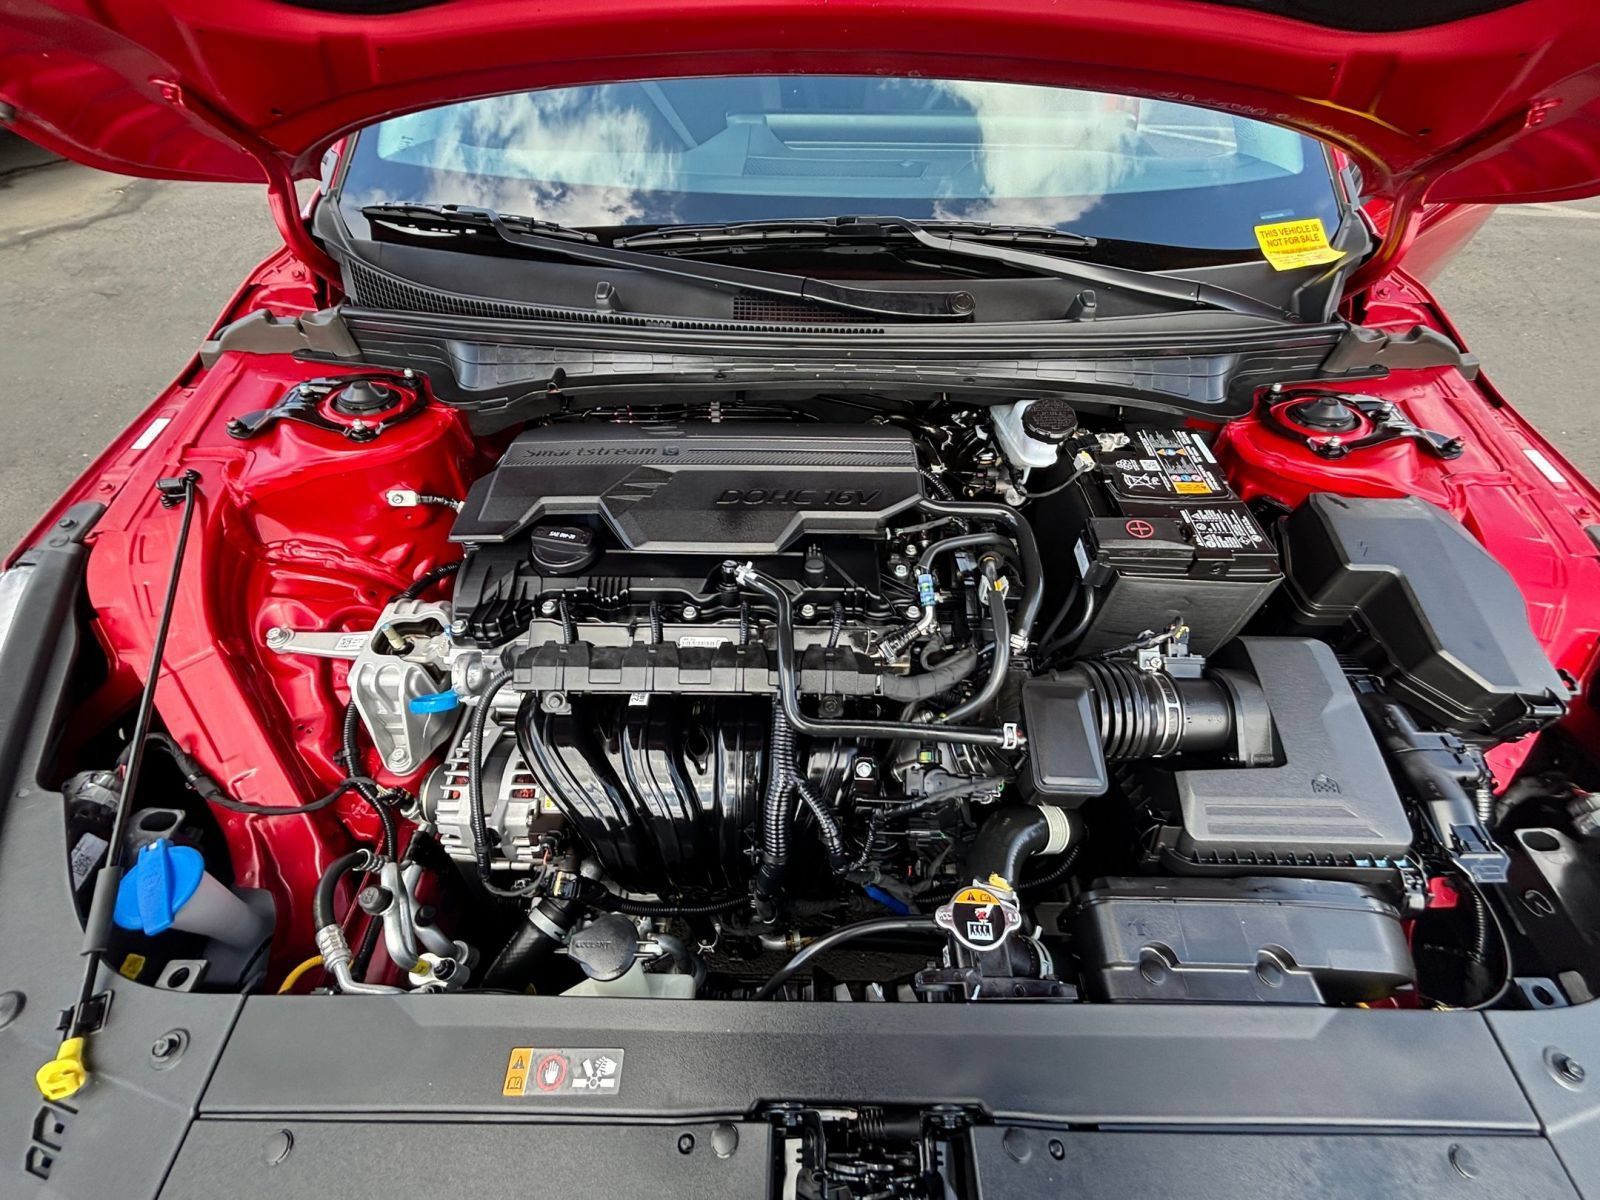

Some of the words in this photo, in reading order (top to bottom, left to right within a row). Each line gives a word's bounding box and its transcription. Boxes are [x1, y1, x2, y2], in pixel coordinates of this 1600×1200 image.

[1260, 229, 1278, 239] THIS
[1279, 225, 1311, 236] VEHICLE
[1311, 223, 1319, 232] IS
[1266, 238, 1282, 248] NOT
[1283, 236, 1300, 245] FOR
[1299, 233, 1320, 243] SALE
[523, 447, 658, 458] Smartstream
[716, 489, 817, 505] DOHC
[824, 488, 882, 506] 16V
